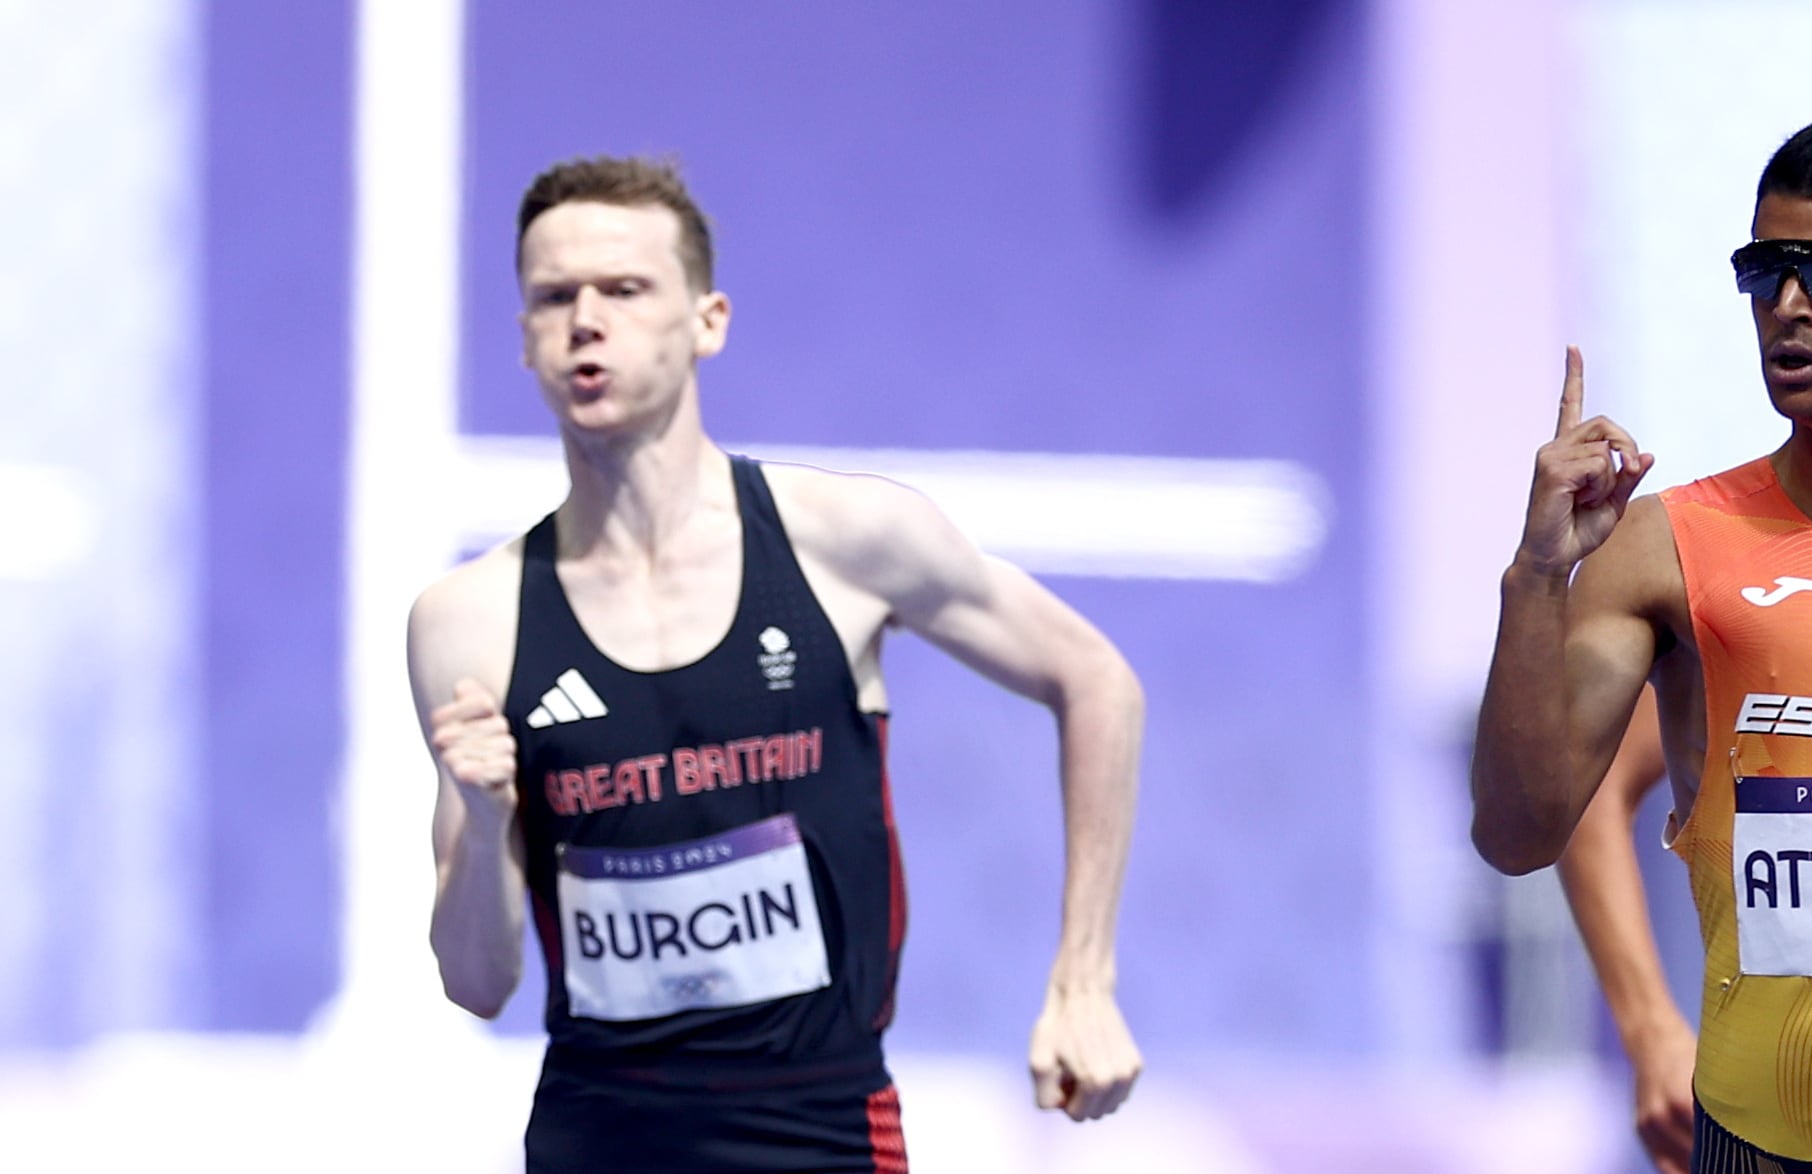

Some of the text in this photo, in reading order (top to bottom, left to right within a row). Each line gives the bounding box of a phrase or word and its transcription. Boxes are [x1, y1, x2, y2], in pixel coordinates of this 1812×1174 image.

[545, 727, 823, 816] GREAT BRITAIN
[602, 842, 733, 873] PARIS 2024
[574, 882, 800, 961] BURGIN
